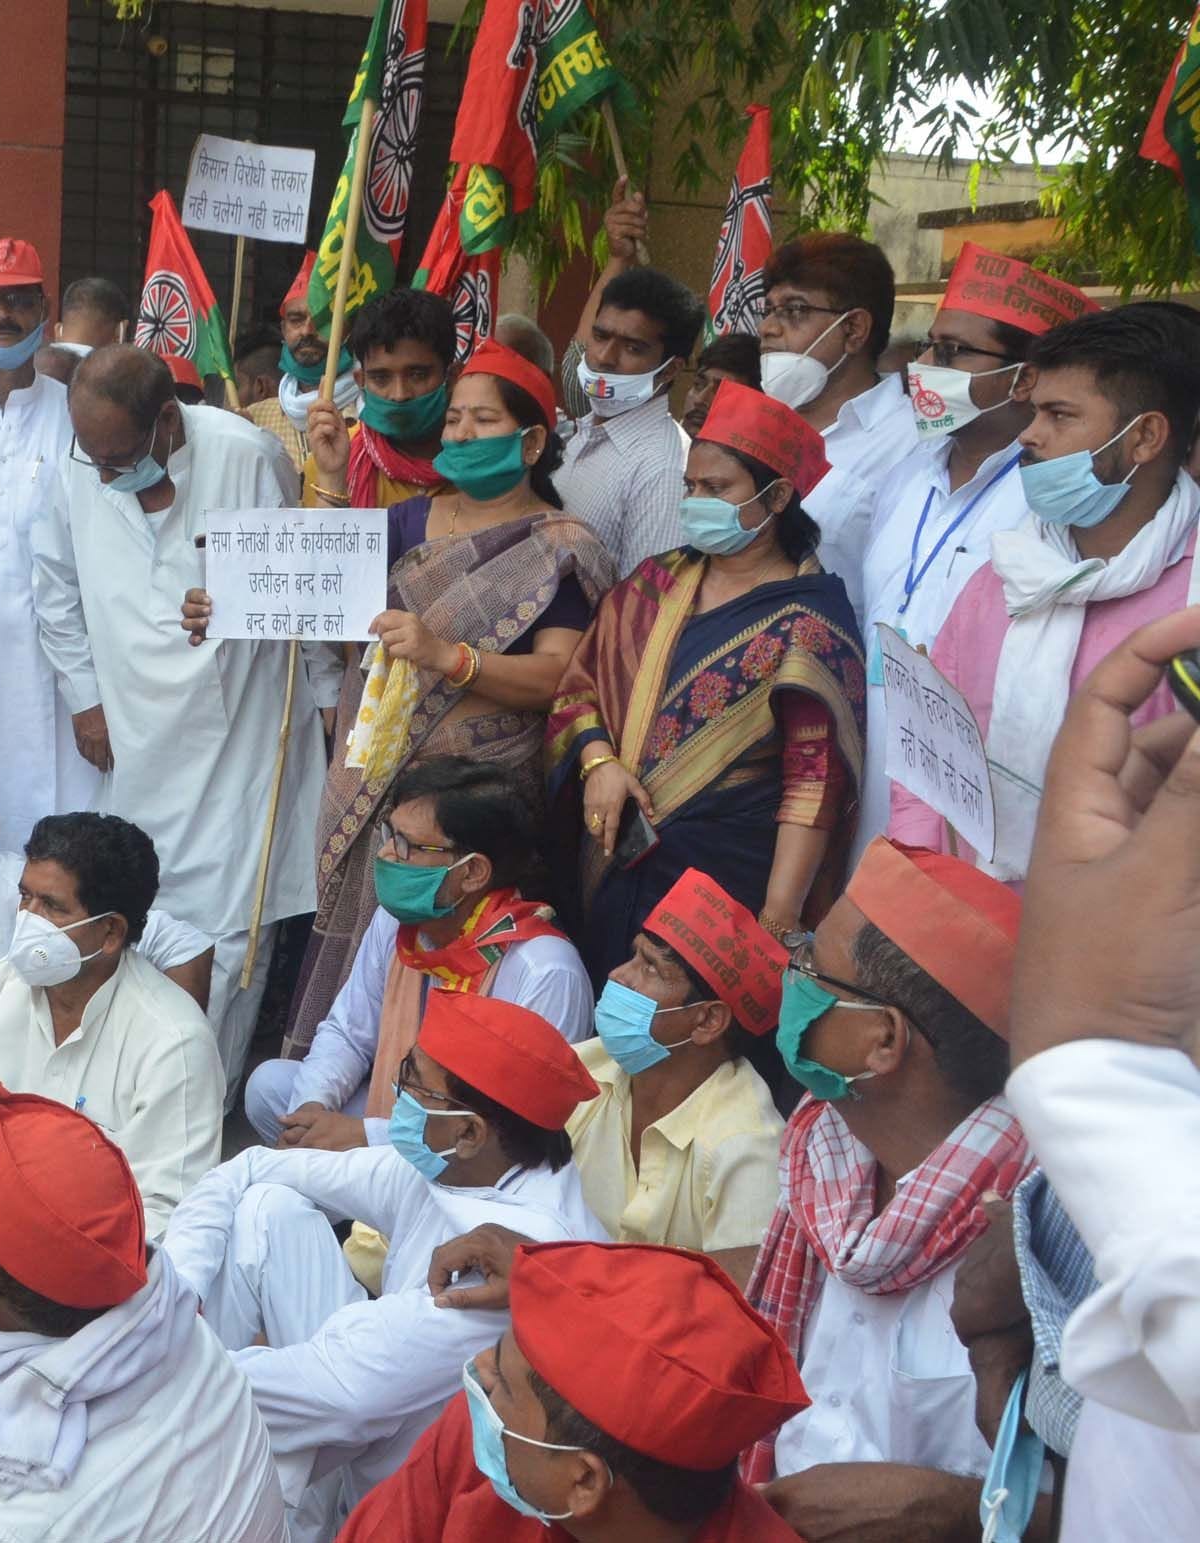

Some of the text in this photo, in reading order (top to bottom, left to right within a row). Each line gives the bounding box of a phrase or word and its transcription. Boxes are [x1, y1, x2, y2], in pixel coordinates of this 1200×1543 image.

[196, 147, 308, 194] किसान विरोधी सरकार
[189, 190, 304, 233] नही चलेगी नही चलेगी
[931, 414, 954, 428] पार्टी
[211, 523, 381, 554] सपा नेताओं और कार्यकर्ताओं का
[248, 565, 343, 598] उत्पीड़न बन्द करो
[246, 605, 344, 636] बन्द करो बन्द करो
